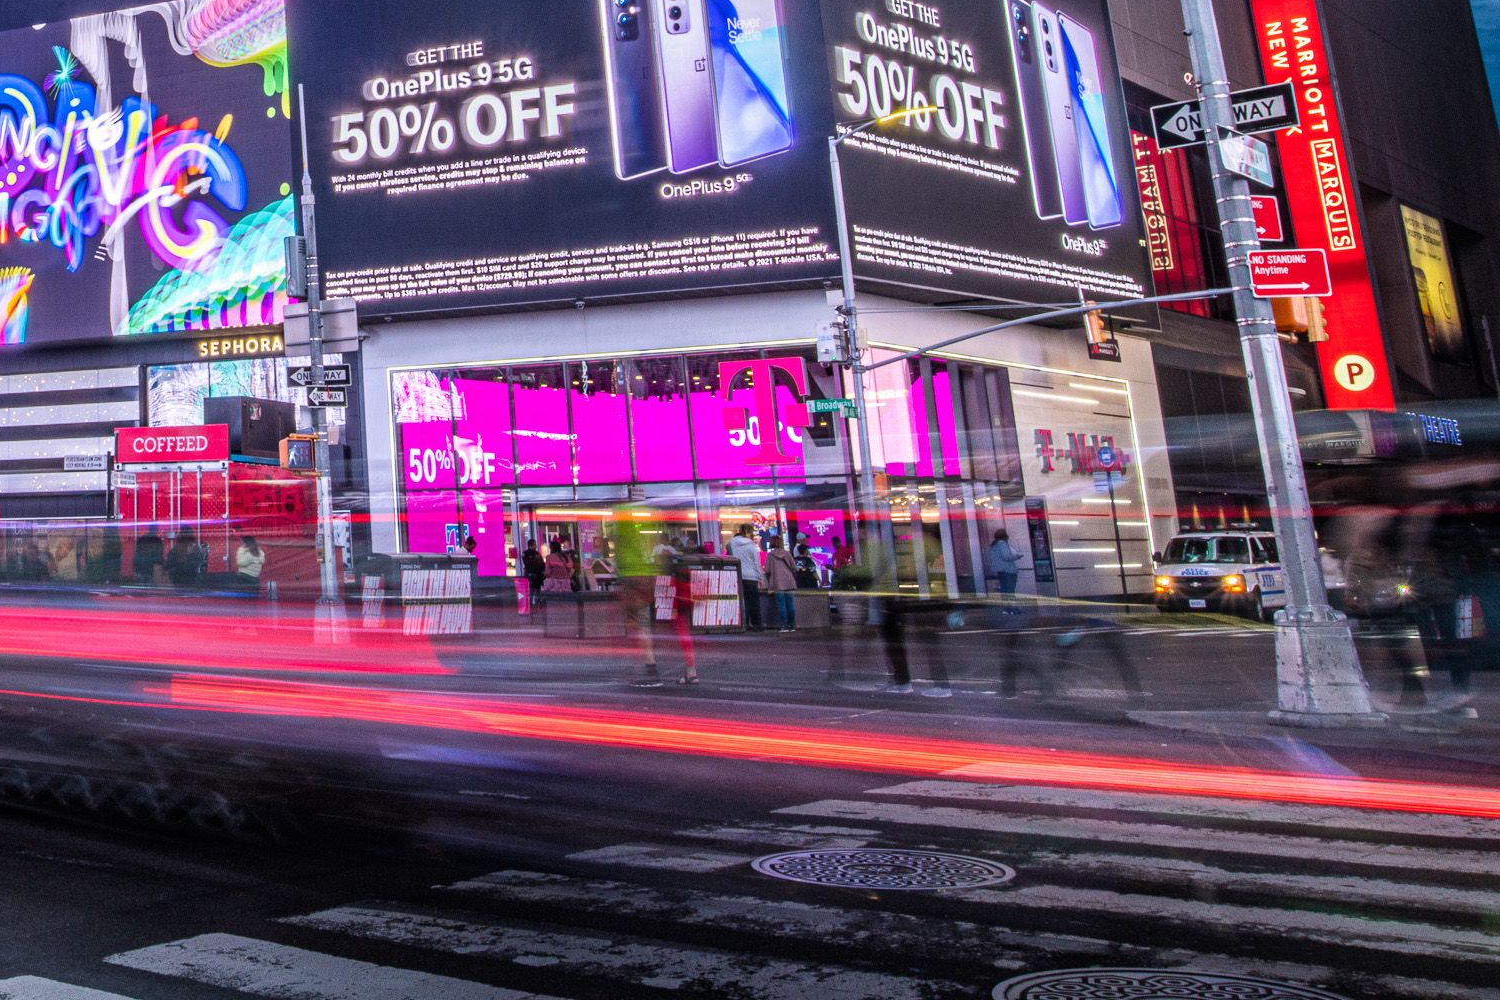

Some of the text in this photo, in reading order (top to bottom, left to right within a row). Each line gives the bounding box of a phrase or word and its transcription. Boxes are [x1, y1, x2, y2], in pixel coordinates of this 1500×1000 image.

[727, 17, 760, 31] Never
[917, 3, 940, 28] THE
[728, 30, 762, 44] Settle
[862, 13, 975, 73] OnePlus 9 5G
[1266, 21, 1290, 68] NEW
[414, 41, 483, 65] GET THE
[371, 57, 533, 99] OnePlus 9 5G
[840, 46, 1008, 150] 50% OFF
[338, 83, 575, 161] 50% OFF
[1176, 100, 1275, 132] ON WAY
[1291, 17, 1329, 132] MARRIOTT
[1315, 143, 1350, 246] MARQUIS
[332, 175, 346, 183] With
[357, 170, 381, 181] monthly
[383, 169, 392, 177] bill
[394, 166, 416, 175] credits
[418, 164, 435, 173] when
[436, 164, 448, 172] you
[451, 161, 462, 169] add
[470, 158, 482, 166] line
[493, 155, 510, 164] trade
[527, 149, 561, 161] qualifying
[563, 146, 587, 155] device.
[661, 173, 749, 198] OnePlus 9 5G
[1062, 234, 1093, 254] OnePlus
[1093, 239, 1100, 256] 9
[1252, 255, 1306, 264] NO STANDING
[1254, 266, 1289, 276] Anytime
[200, 336, 283, 357] SEPHORA
[324, 371, 341, 380] WAY
[1347, 363, 1364, 385] P
[313, 392, 341, 401] ONE WAY
[817, 401, 852, 411] Broadway
[719, 356, 811, 465] T
[1420, 413, 1463, 446] THEATRE
[133, 436, 208, 454] COFFEED
[409, 447, 497, 485] 50% OFF
